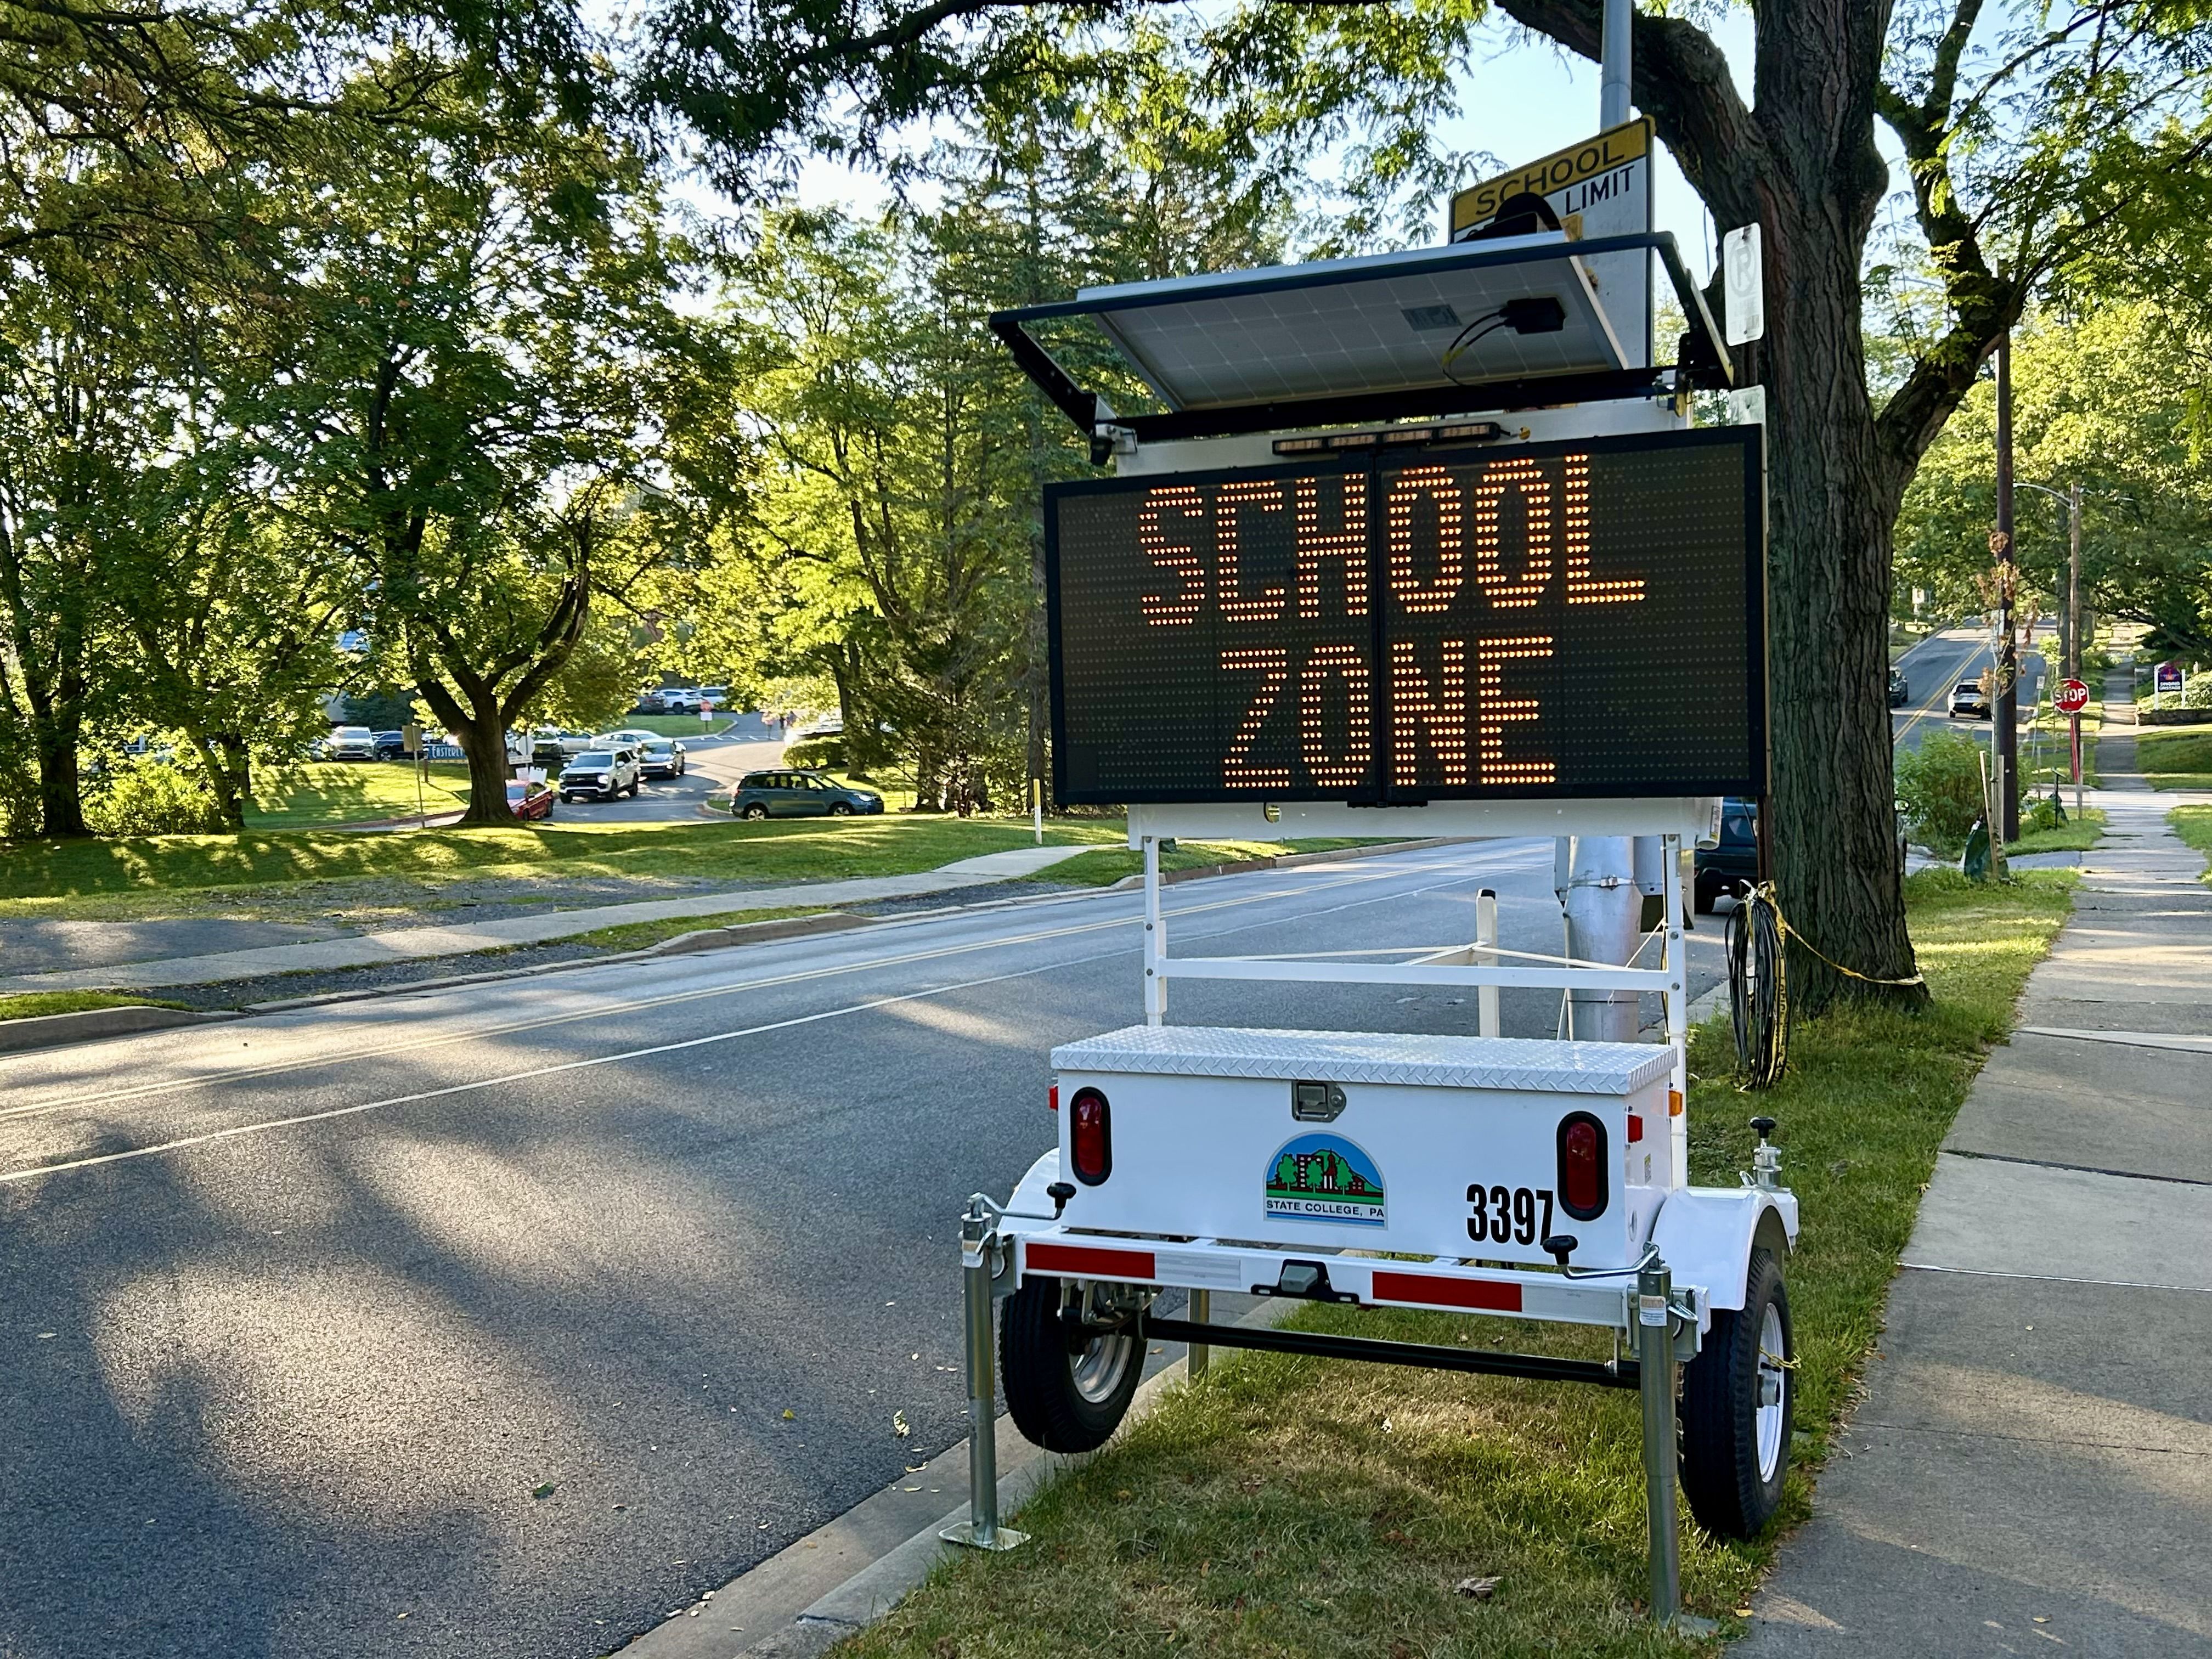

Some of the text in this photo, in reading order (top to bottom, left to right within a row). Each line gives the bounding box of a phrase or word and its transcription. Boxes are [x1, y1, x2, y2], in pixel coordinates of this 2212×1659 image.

[1476, 140, 1624, 216] SCHOOL
[1565, 165, 1635, 216] LIMIT
[1139, 453, 1646, 626] SCHOOL
[1221, 636, 1556, 788] ZONE
[2054, 687, 2086, 703] STOP
[1266, 1200, 1384, 1217] STATE COLLEGE, PA
[1466, 1183, 1554, 1246] 3397
